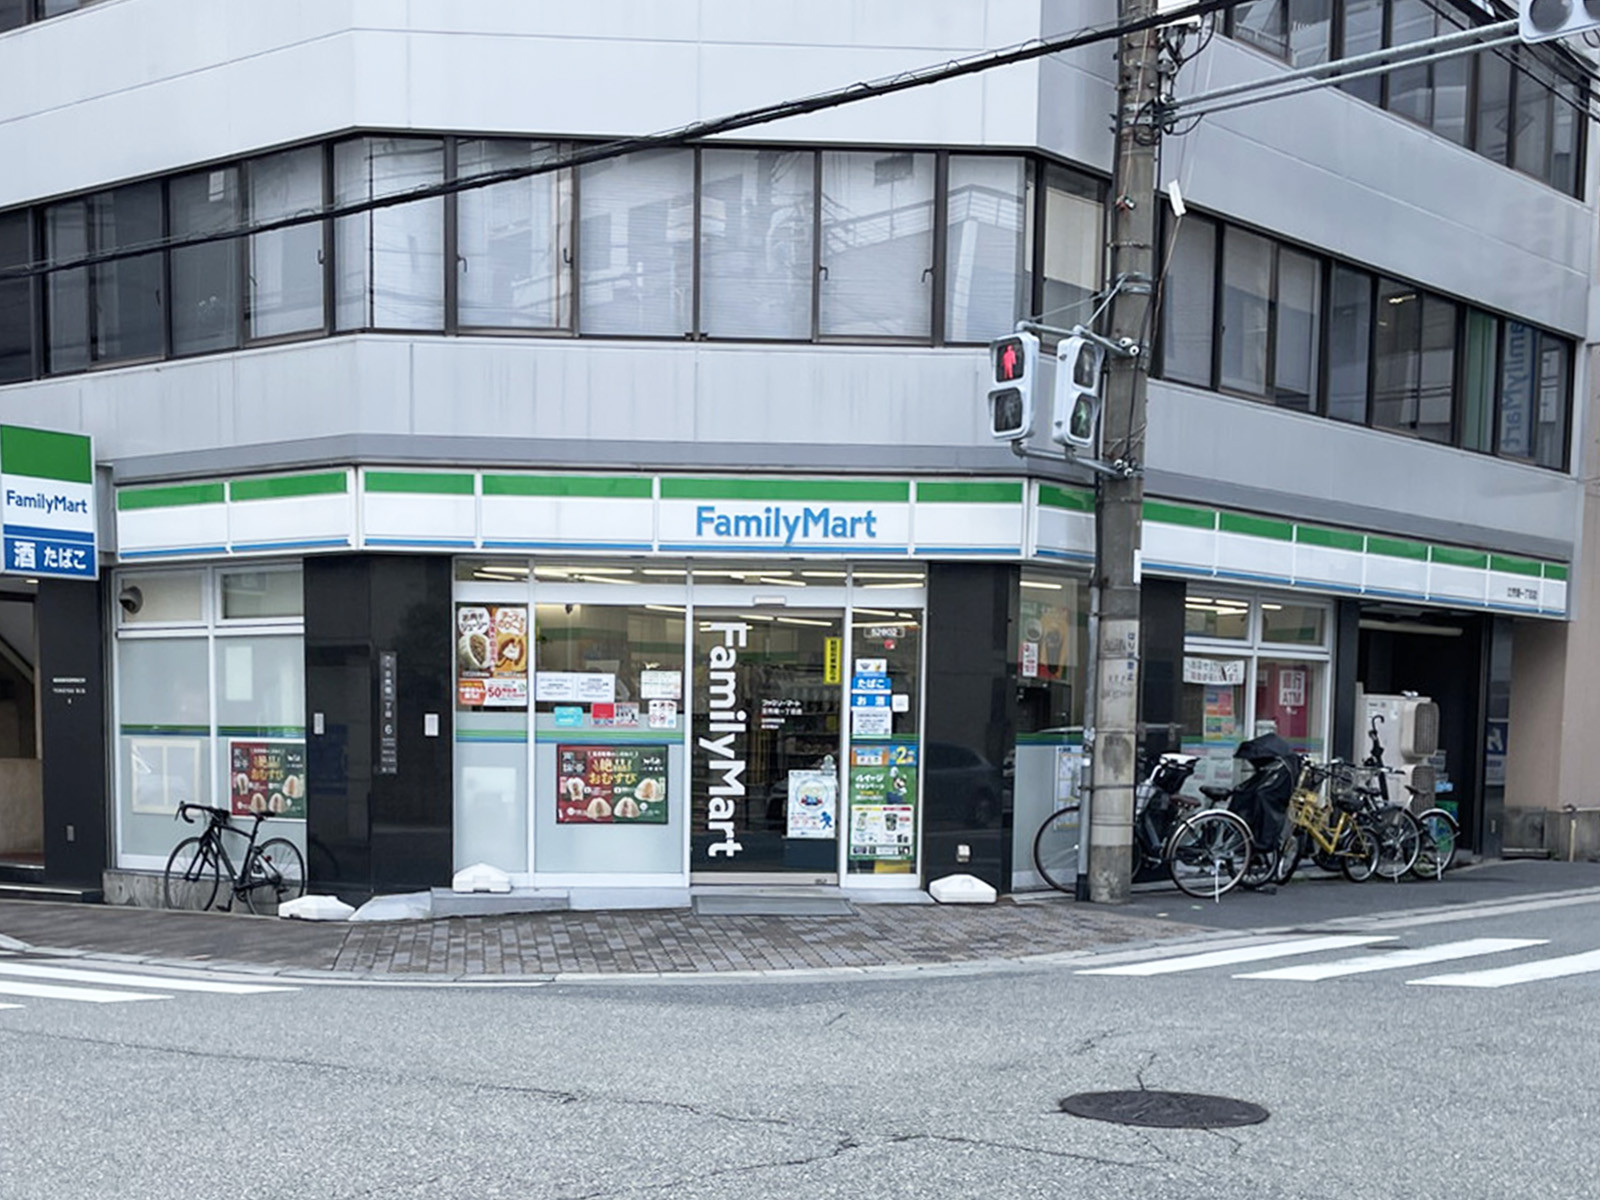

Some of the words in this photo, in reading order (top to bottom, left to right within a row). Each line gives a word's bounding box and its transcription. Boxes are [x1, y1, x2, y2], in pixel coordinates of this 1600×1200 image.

[6, 490, 88, 514] FamilyMart
[696, 506, 877, 546] FamilyMart
[14, 541, 36, 569] 酒
[44, 546, 87, 569] たばこ
[857, 678, 886, 690] たばこ
[1283, 691, 1301, 703] ATM
[698, 621, 748, 858] FamilyMart
[588, 772, 638, 785] おむすび
